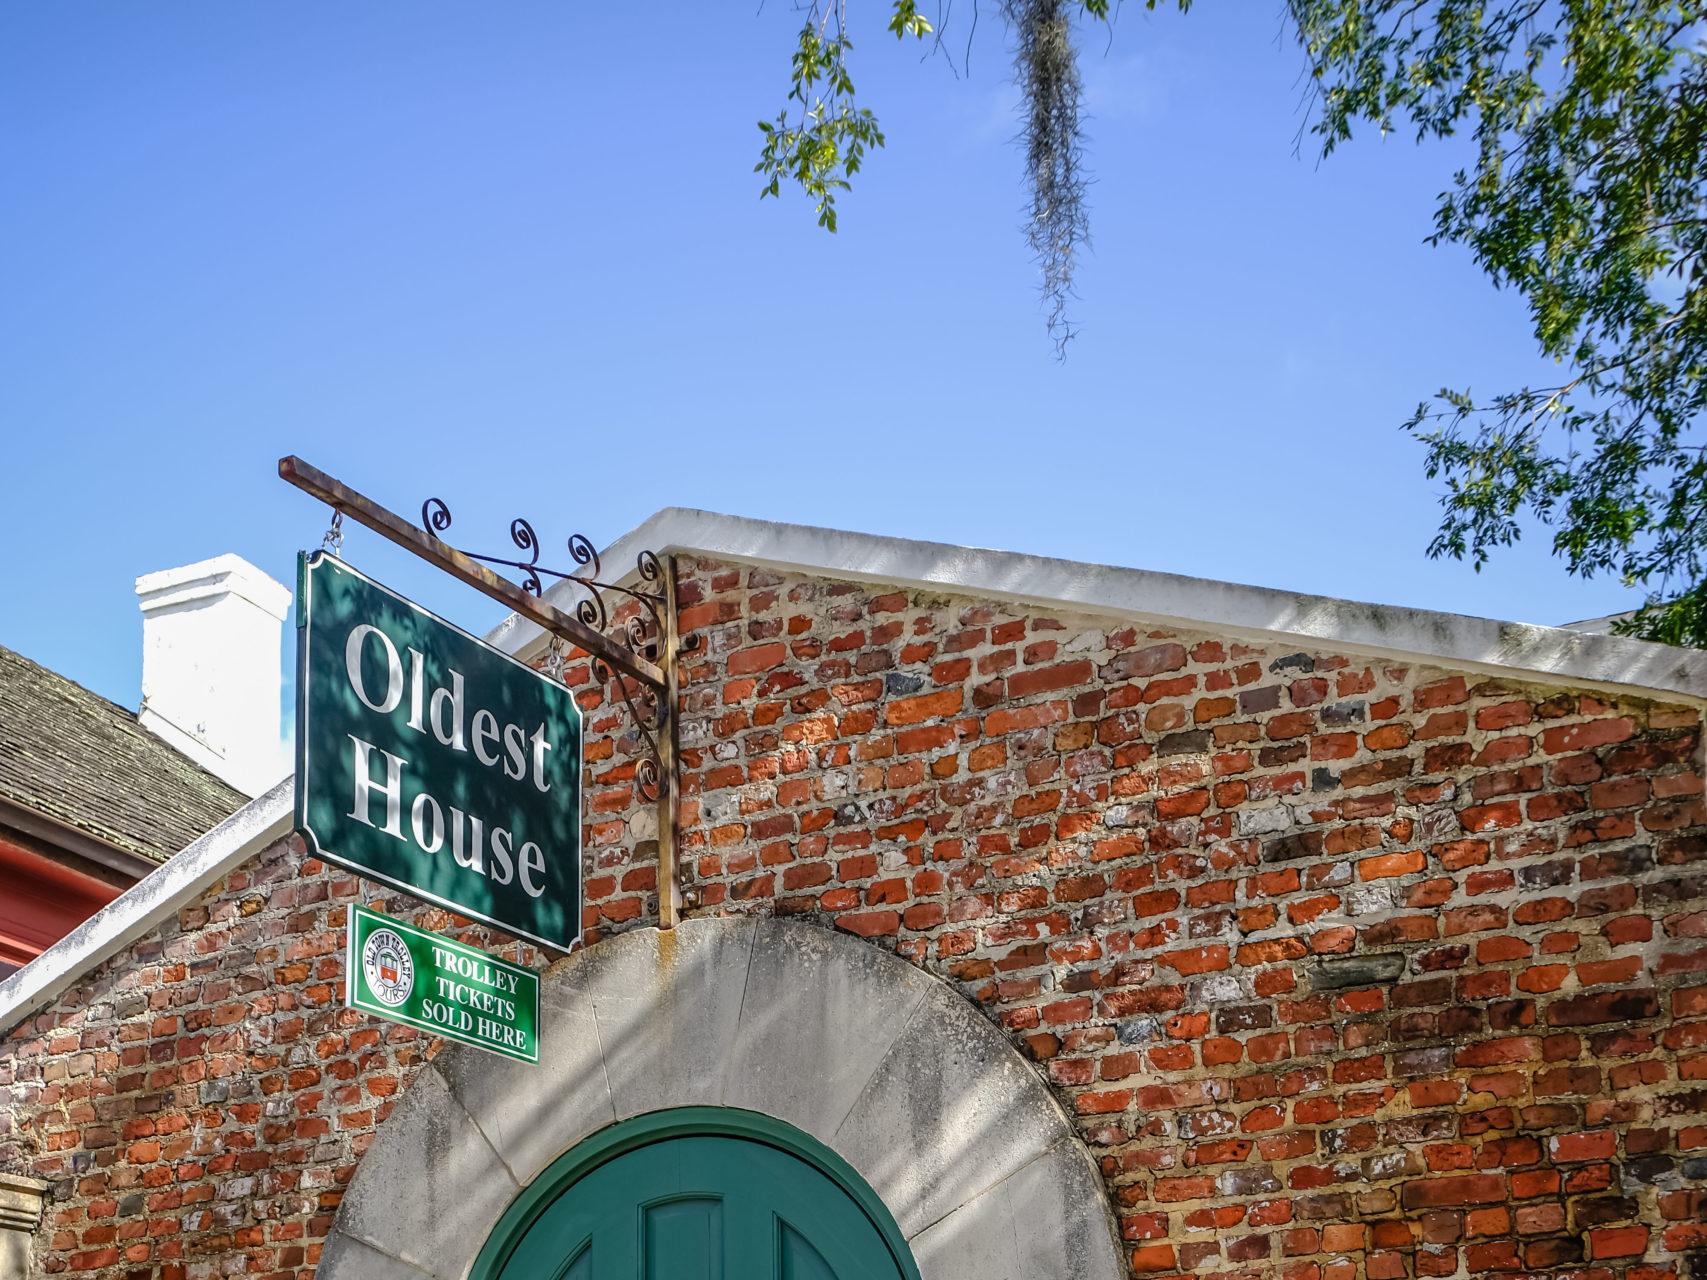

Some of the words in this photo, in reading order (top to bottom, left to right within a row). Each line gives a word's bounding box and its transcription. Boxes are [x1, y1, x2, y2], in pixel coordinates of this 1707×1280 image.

[345, 623, 551, 793] Oldest
[347, 733, 546, 897] House
[366, 946, 376, 966] OLD
[371, 933, 390, 951] TOWN
[391, 937, 411, 980] TROLLEY
[432, 946, 519, 994] TROLLEY
[373, 975, 405, 1002] TOURS
[435, 976, 515, 1021] TICKETS
[422, 998, 473, 1032] SOLD
[477, 1016, 527, 1050] HERE
